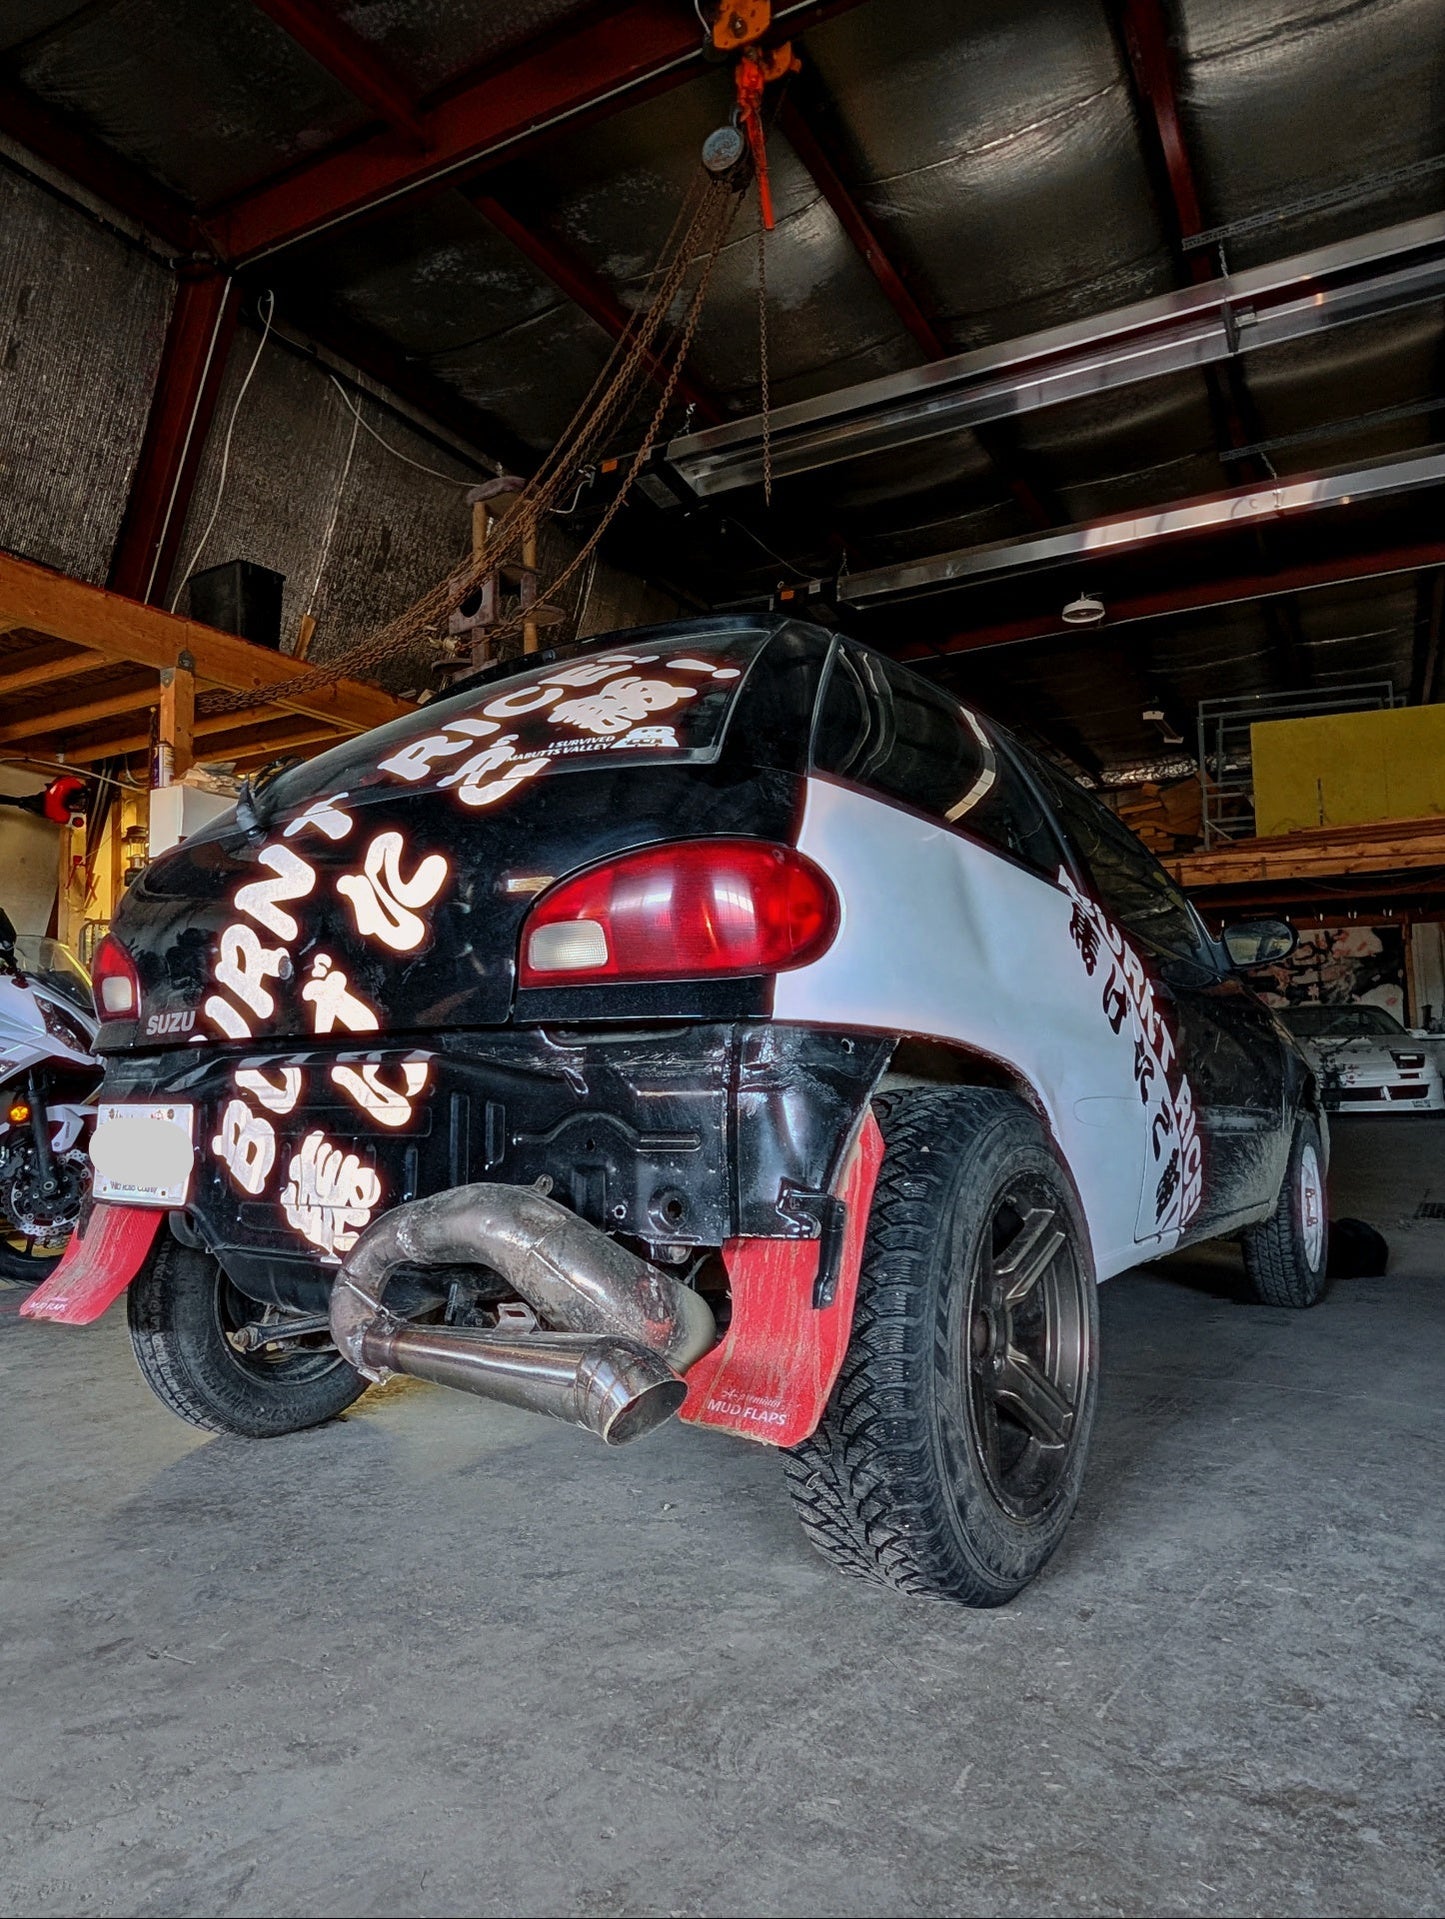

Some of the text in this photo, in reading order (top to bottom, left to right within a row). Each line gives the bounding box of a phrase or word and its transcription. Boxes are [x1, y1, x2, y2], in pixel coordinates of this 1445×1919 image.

[555, 735, 616, 748] SURVIVED
[562, 743, 612, 754] VALLEY
[146, 1010, 196, 1036] SUZU
[707, 1399, 788, 1425] MUD FLAPS
